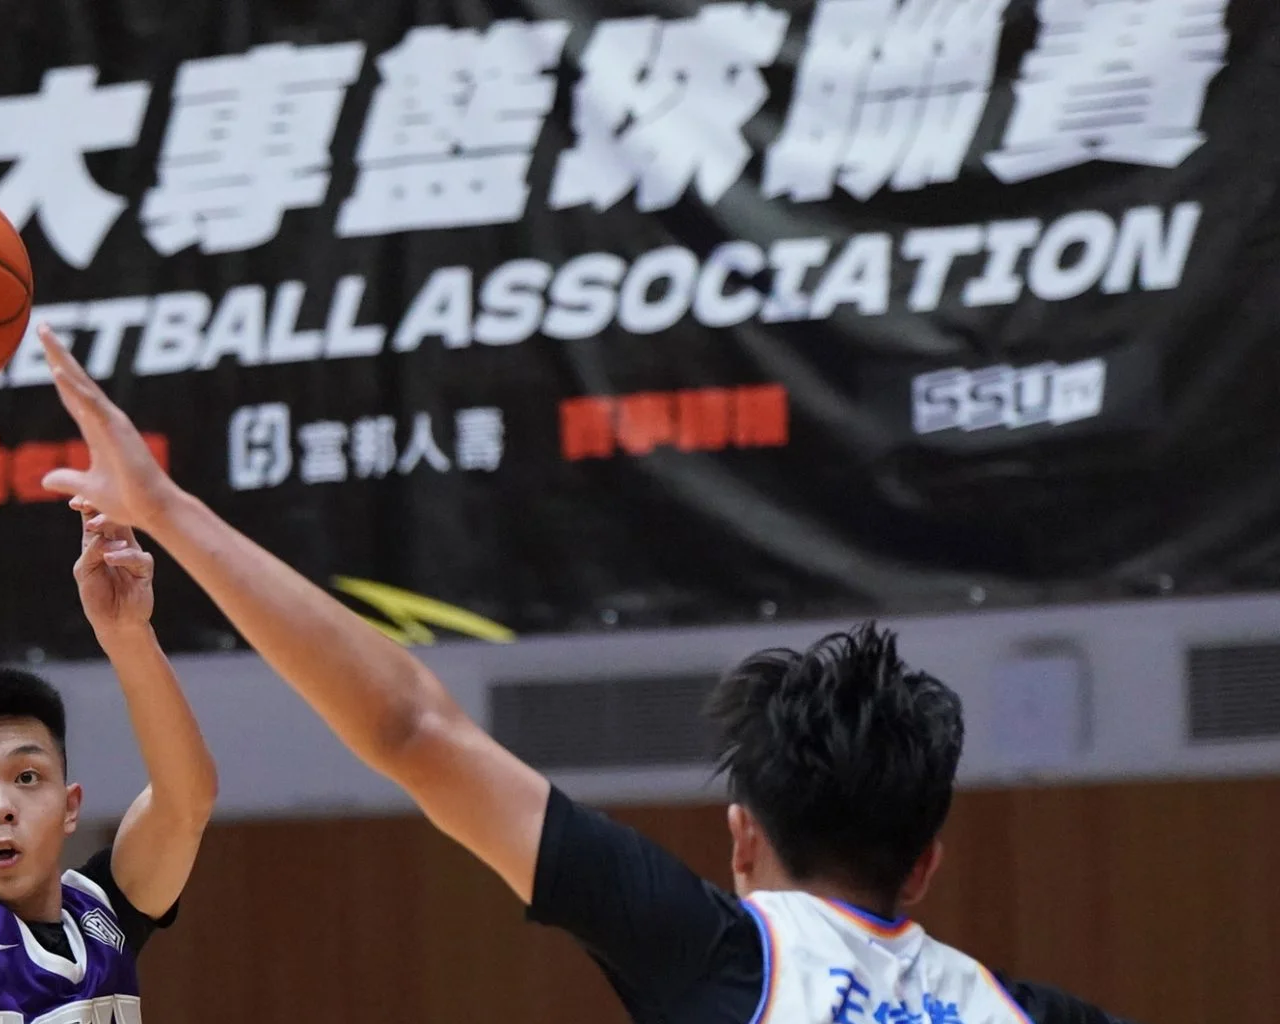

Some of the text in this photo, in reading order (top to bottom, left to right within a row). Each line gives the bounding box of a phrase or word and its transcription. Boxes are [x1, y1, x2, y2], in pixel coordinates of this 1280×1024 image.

[391, 202, 1202, 353] ASSOCIATION
[298, 404, 506, 485] 富邦人壽
